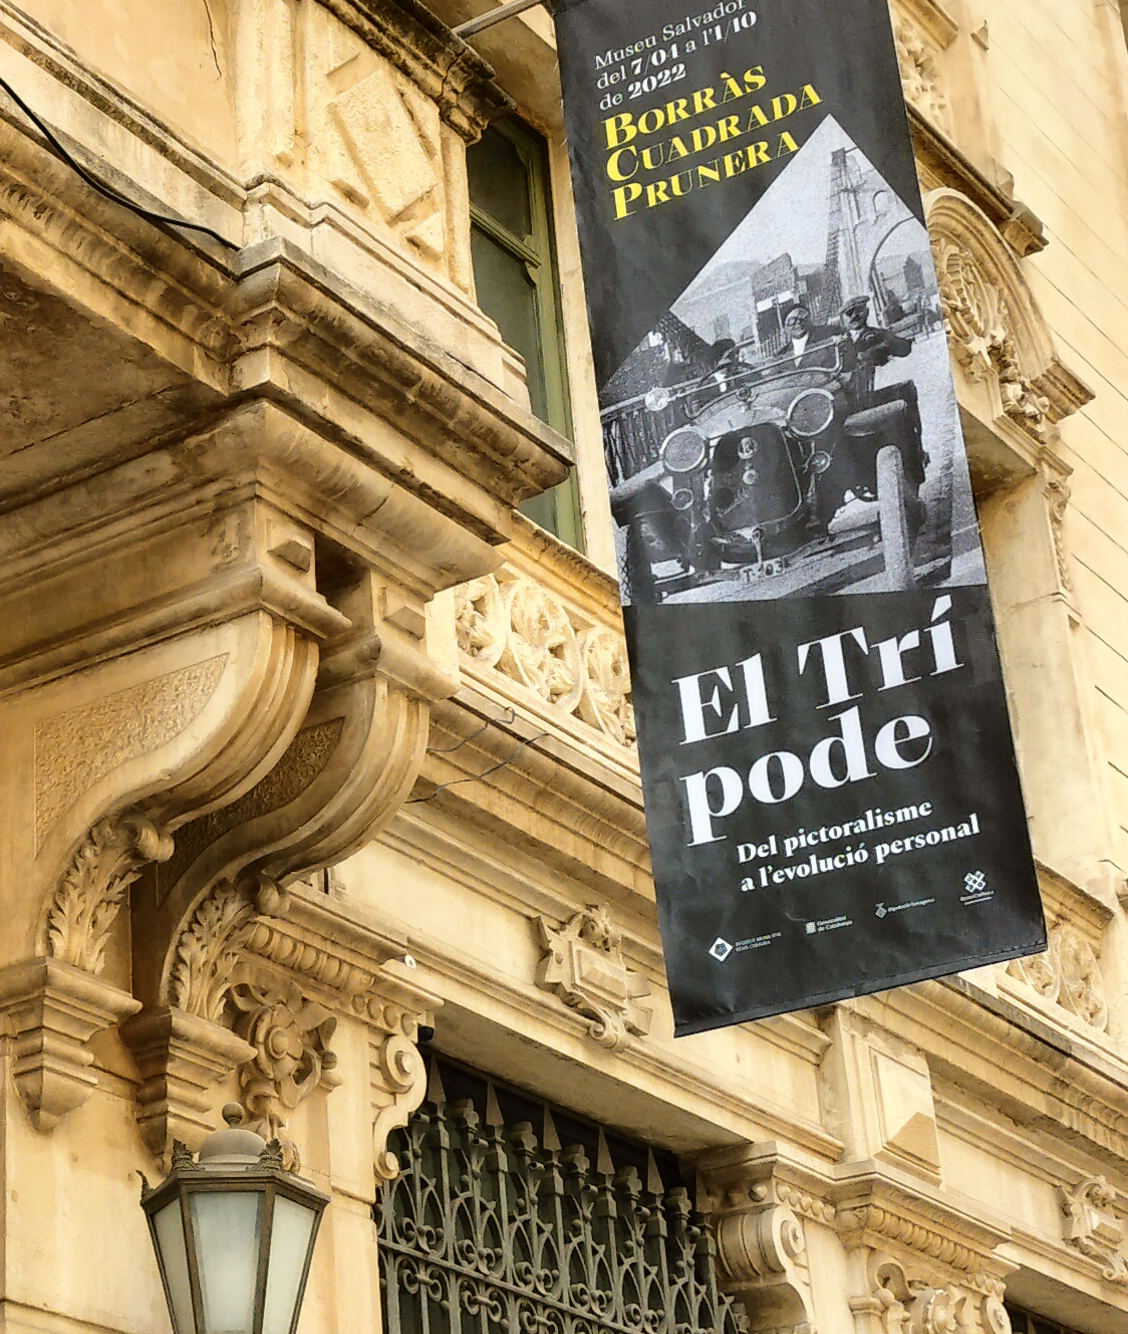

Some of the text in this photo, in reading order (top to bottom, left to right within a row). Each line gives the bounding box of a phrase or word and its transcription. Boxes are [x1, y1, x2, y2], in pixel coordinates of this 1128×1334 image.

[595, 34, 657, 70] Museu
[596, 65, 627, 90] del
[630, 42, 679, 76] 7/04
[685, 38, 697, 54] a
[599, 63, 686, 111] de 2022
[606, 83, 824, 182] CUADRADA
[609, 130, 800, 221] PRUNERA
[672, 594, 965, 745] El Trí
[679, 705, 933, 847] pode
[736, 800, 933, 864] Del pictoralisme
[740, 877, 756, 892] a
[874, 813, 981, 864] personal
